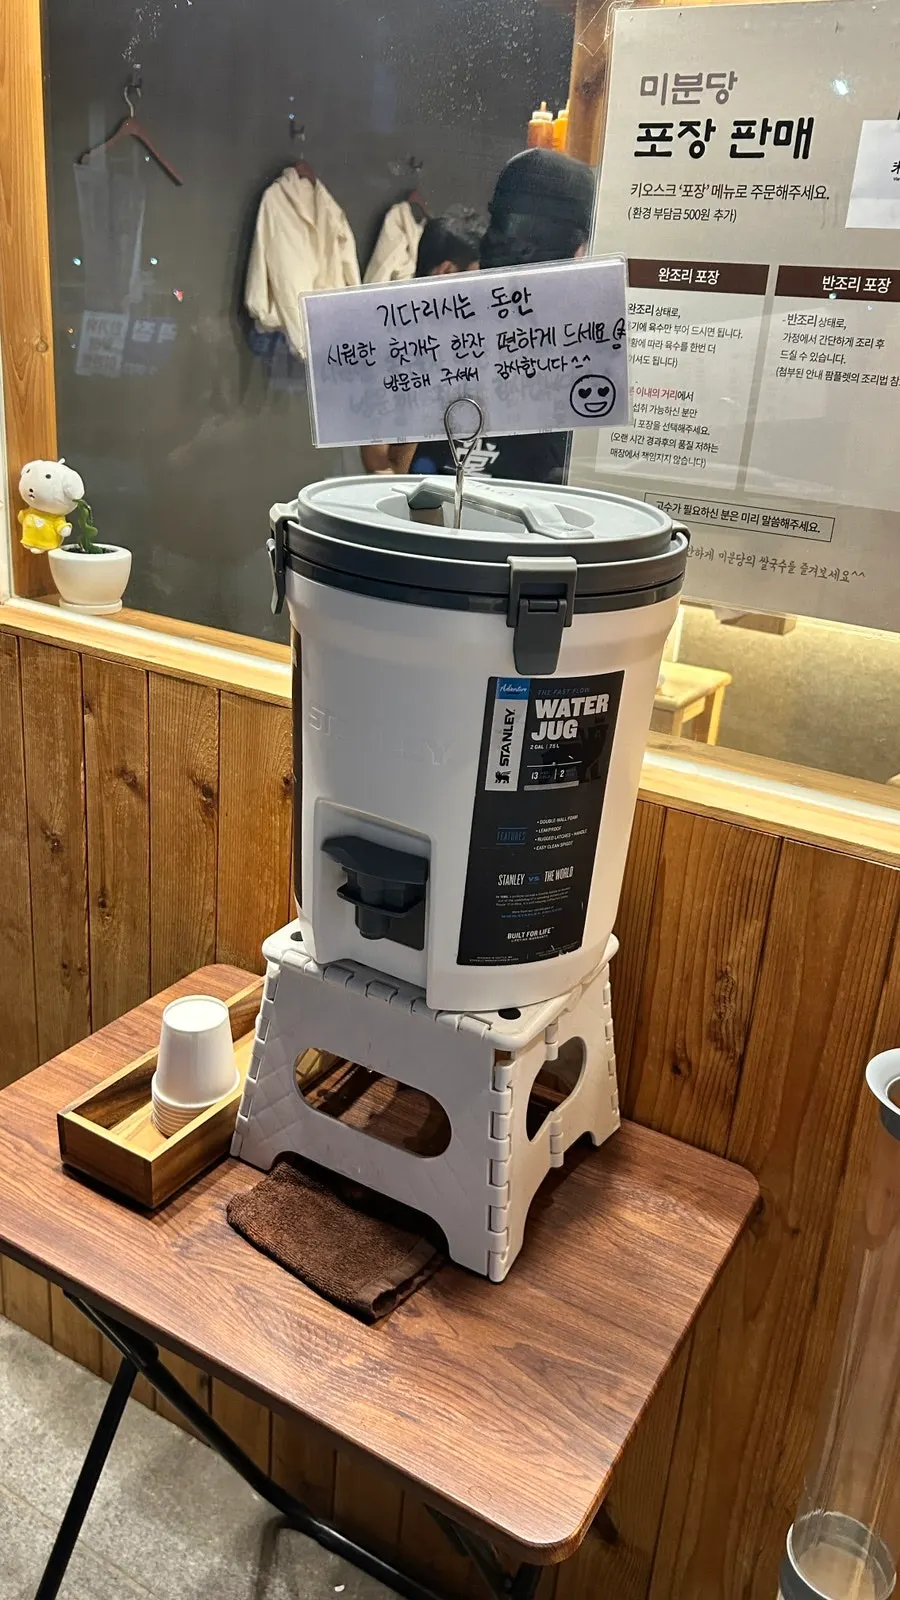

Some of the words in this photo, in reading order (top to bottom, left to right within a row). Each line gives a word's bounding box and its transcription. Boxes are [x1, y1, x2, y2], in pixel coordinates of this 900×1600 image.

[640, 71, 738, 106] 미분당
[634, 118, 717, 159] 포장
[729, 117, 815, 160] 판매
[630, 182, 677, 198] 키오스크
[711, 184, 748, 200] 메뉴로
[750, 184, 831, 201] 주문해주세요.
[627, 206, 652, 221] (환경
[653, 207, 683, 221] 부담금
[683, 208, 711, 222] 500원
[713, 209, 738, 223] 추가)
[658, 267, 693, 284] 완조리
[694, 269, 721, 285] 포장
[822, 275, 862, 293] 반조리
[863, 277, 892, 294] 포장
[376, 293, 476, 327] 기다리시는
[490, 286, 534, 319] 동안
[628, 303, 654, 316] 완조리
[655, 306, 681, 319] 상태로,
[628, 321, 648, 332] 기에
[649, 322, 672, 334] 육수만
[673, 324, 690, 336] 부어
[691, 325, 715, 338] 드시면
[717, 327, 743, 340] 됩니다.
[787, 313, 818, 328] 반조리
[818, 317, 847, 331] 상태로,
[327, 341, 377, 367] 시원한
[388, 335, 441, 366] 헛개수
[451, 332, 486, 359] 한잔
[496, 326, 557, 353] 편하게
[628, 337, 647, 348] 황에
[647, 339, 663, 350] 따라
[665, 341, 689, 352] 육수를
[690, 343, 707, 354] 한번
[707, 344, 716, 354] 더
[782, 332, 818, 345] 가정에서
[819, 335, 855, 348] 간단하게
[855, 337, 874, 349] 조리
[875, 338, 886, 350] 후
[780, 349, 798, 361] 드실
[799, 351, 808, 361] 수
[809, 351, 847, 365] 있습니다.
[383, 371, 432, 392] 방문해
[805, 368, 823, 380] 안내
[861, 373, 888, 386] 조리법
[636, 386, 660, 399] 이내의
[661, 389, 694, 402] 거리에서
[649, 404, 681, 417] 가능하신
[637, 419, 661, 432] 포장을
[629, 435, 645, 446] 시간
[678, 439, 694, 451] 품질
[695, 441, 719, 454] 저하는
[610, 447, 640, 460] 매장에서
[641, 450, 672, 463] 책임지지
[683, 505, 720, 519] 필요하신
[721, 509, 739, 522] 분은
[741, 512, 760, 526] 미리
[762, 514, 821, 535] 말씀해주세요.
[687, 544, 715, 562] 안하게
[719, 550, 757, 568] 미분당의
[758, 555, 797, 575] 쌀국수를
[535, 693, 610, 719] WATER
[499, 708, 515, 767] STANLEY
[531, 719, 579, 741] JUG
[497, 873, 526, 886] STANLEY
[544, 869, 556, 882] THE
[555, 865, 574, 881] WORLD
[507, 931, 526, 940] BUILT
[526, 929, 539, 938] FOR
